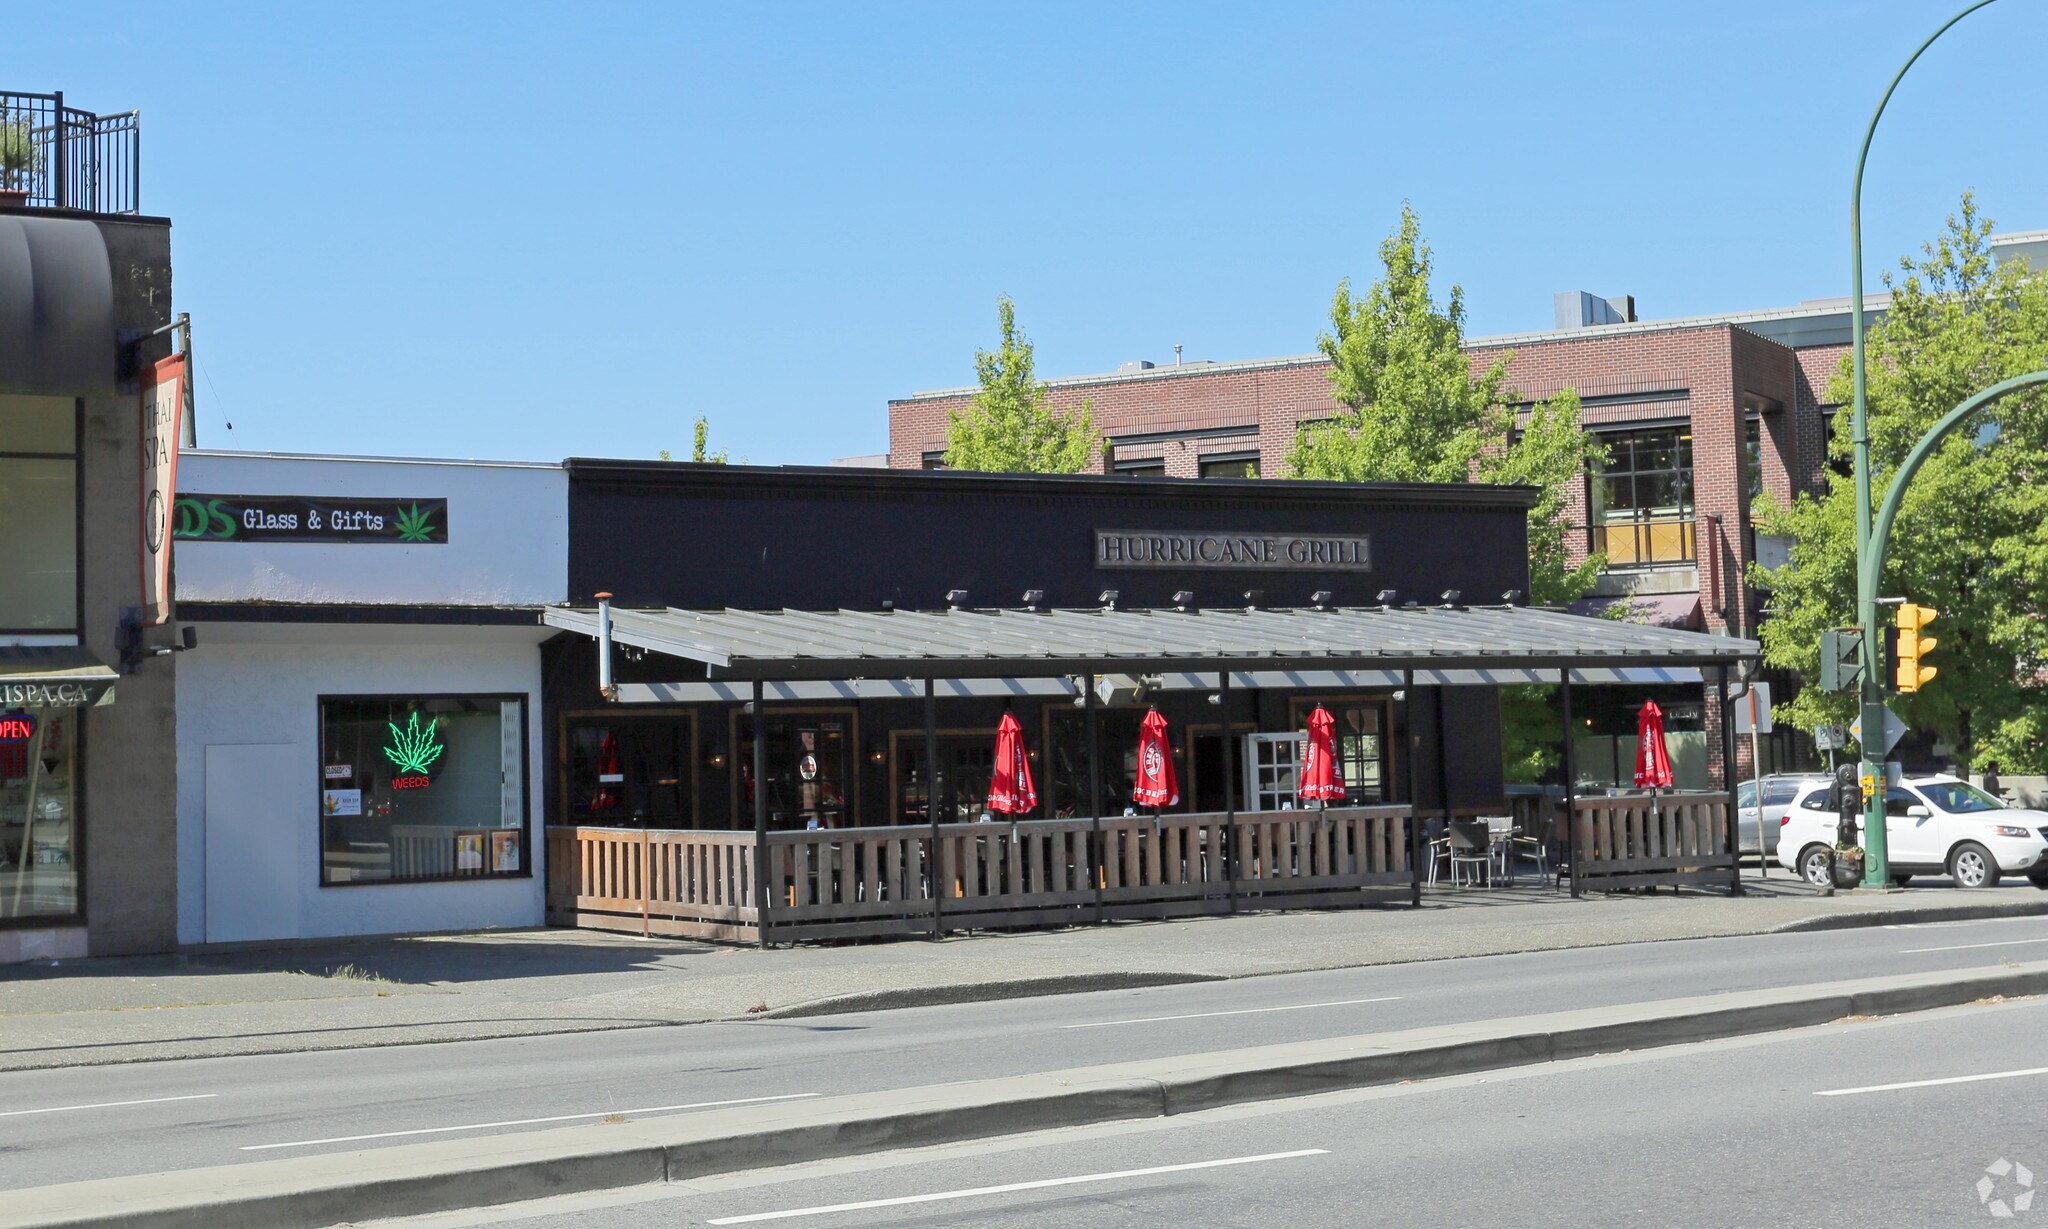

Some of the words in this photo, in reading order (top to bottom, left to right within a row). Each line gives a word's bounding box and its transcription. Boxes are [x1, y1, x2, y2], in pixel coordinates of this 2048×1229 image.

[145, 398, 172, 430] THAI
[144, 433, 169, 471] SPA
[174, 499, 237, 538] DS
[243, 508, 298, 530] Glass
[307, 509, 322, 530] &
[331, 510, 384, 531] Gifts
[1101, 536, 1277, 564] HURRICANE
[1286, 539, 1367, 565] GRILL
[0, 721, 31, 738] PEN
[392, 776, 430, 789] WEEDS
